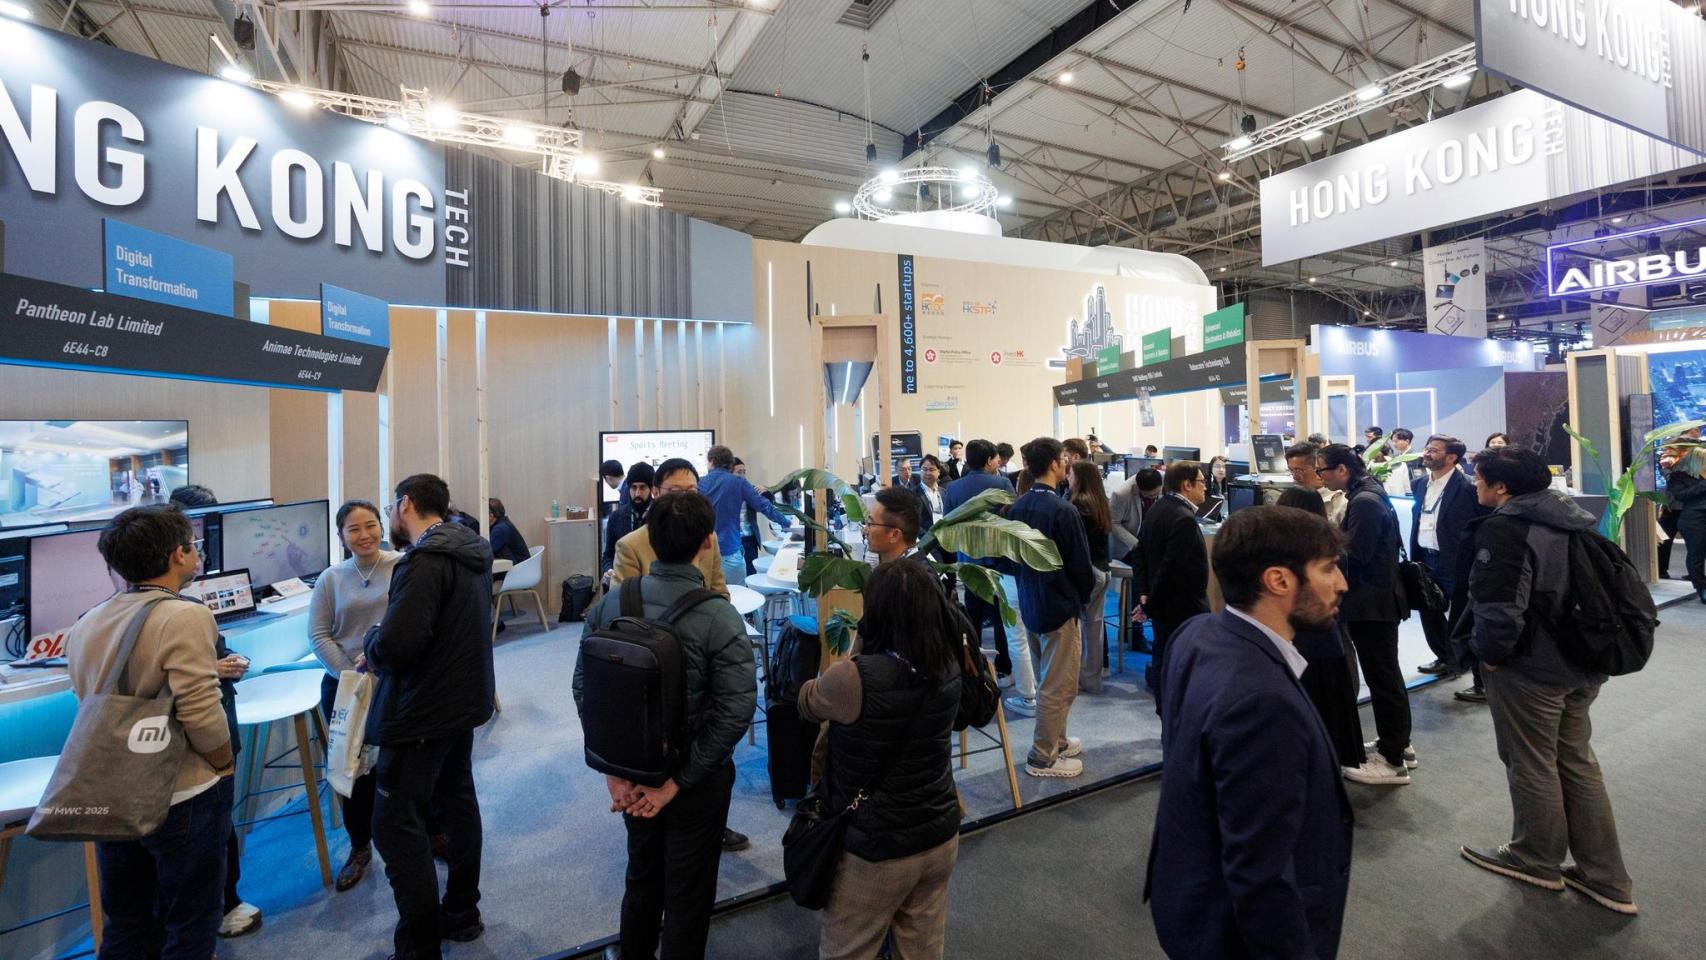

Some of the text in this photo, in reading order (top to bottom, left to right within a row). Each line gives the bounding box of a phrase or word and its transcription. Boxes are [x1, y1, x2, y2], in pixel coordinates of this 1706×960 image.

[1596, 0, 1661, 83] KONG
[1660, 28, 1673, 89] TECH
[1543, 102, 1564, 156] TECH
[1289, 117, 1534, 227] HONG KONG
[196, 126, 435, 259] KONG
[445, 188, 469, 267] TECH
[116, 245, 153, 268] Digital
[115, 267, 198, 300] Transformation
[903, 259, 913, 311] startups
[15, 298, 164, 336] Pantheon Lab Limited
[327, 300, 347, 316] Digital
[327, 317, 371, 337] Transformation
[903, 314, 915, 356] 4,600+
[62, 340, 109, 357] 6E44-C8
[262, 339, 364, 366] Animae Technologies Limited
[905, 359, 914, 374] to
[630, 440, 689, 450] Sports Meeting
[84, 806, 110, 815] 2025
